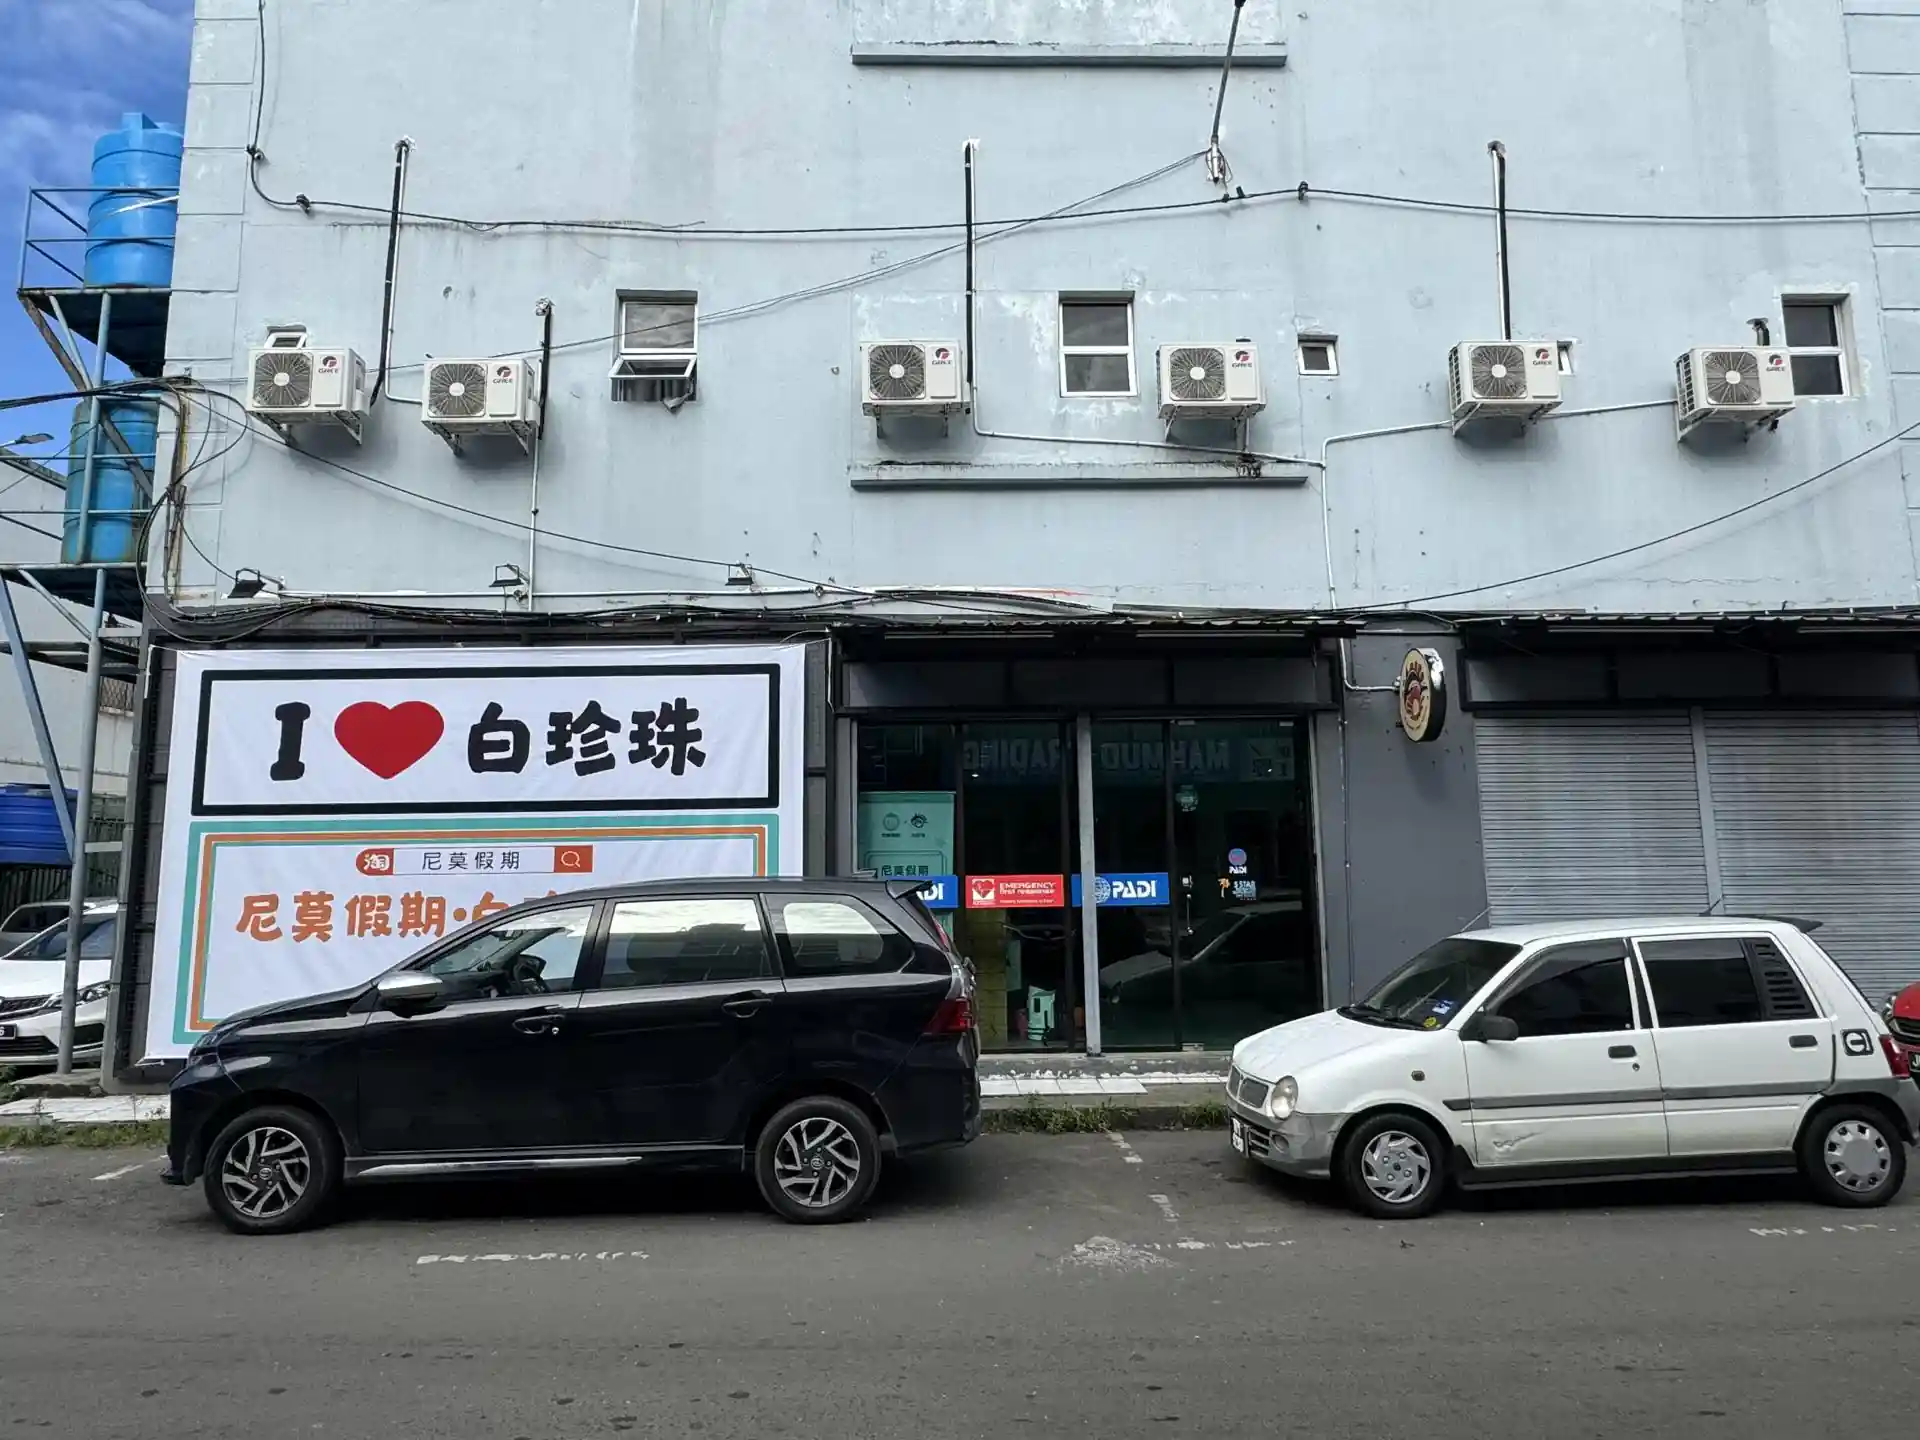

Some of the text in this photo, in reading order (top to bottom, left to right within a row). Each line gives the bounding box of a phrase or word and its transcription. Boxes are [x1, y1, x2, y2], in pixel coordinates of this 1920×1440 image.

[270, 697, 707, 781] I 白珍珠
[363, 851, 521, 871] 淘 尼莫假期
[1112, 880, 1157, 899] PADI
[236, 889, 557, 943] 尼莫假期·
